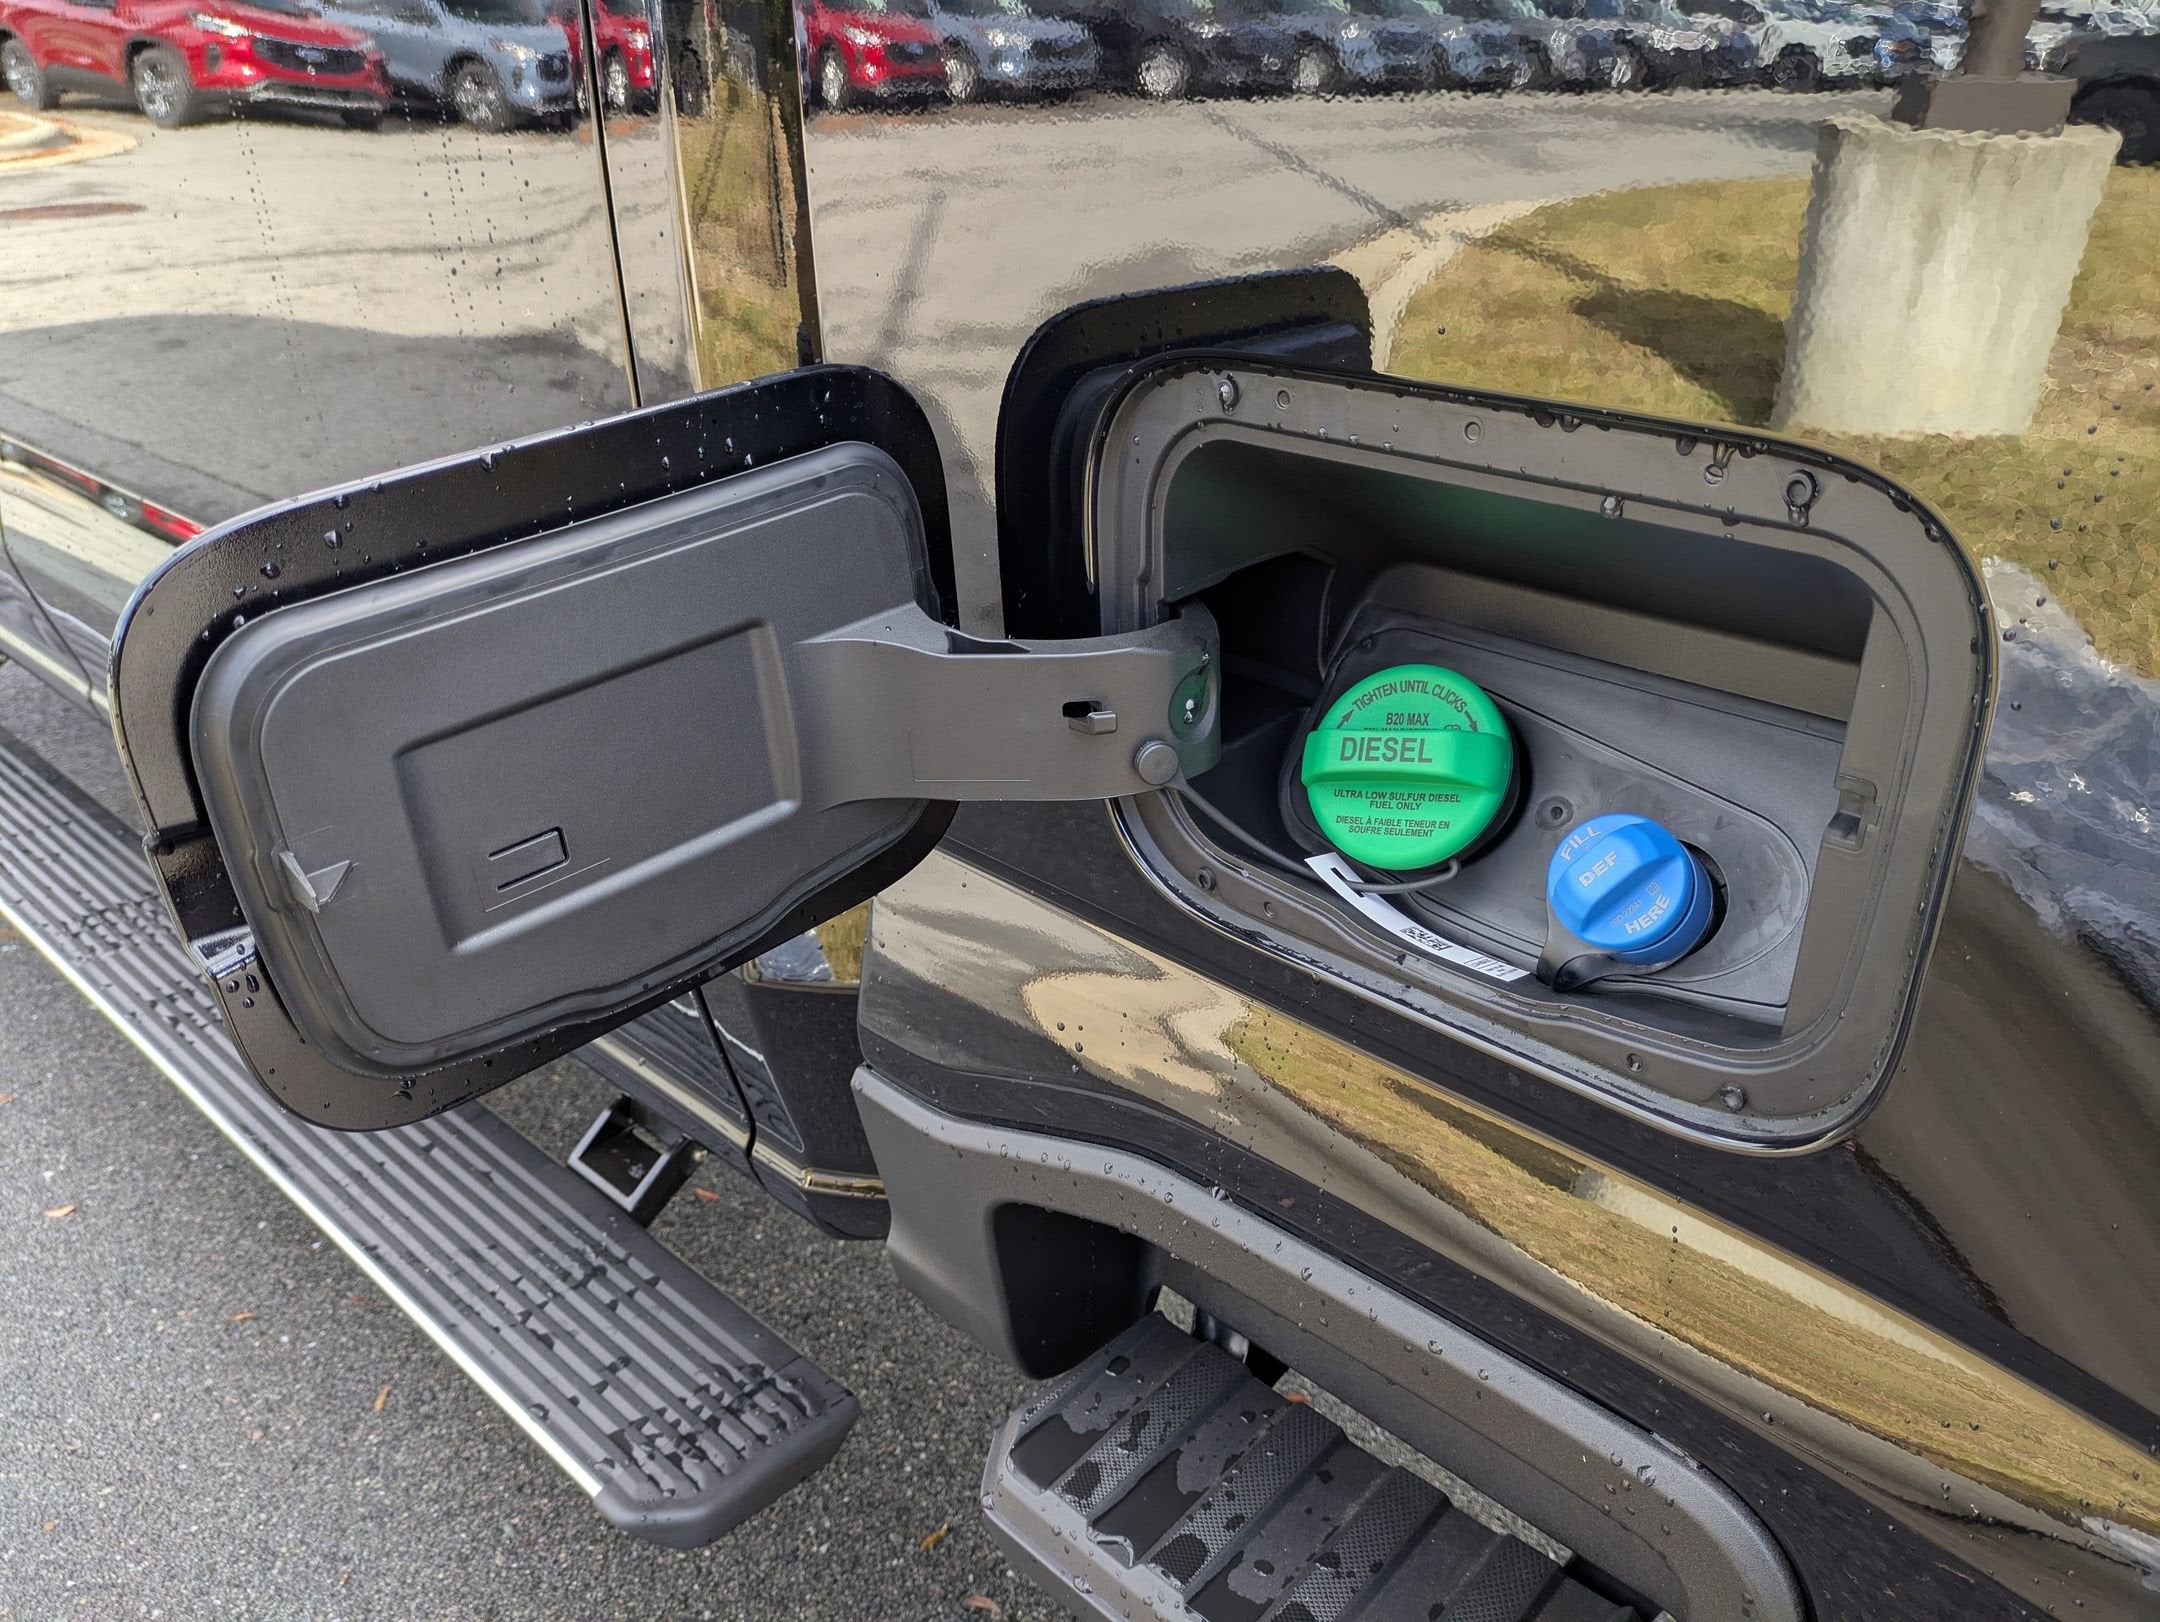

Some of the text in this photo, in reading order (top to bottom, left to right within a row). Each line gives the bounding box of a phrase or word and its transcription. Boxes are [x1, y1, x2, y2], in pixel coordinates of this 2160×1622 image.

[1352, 680, 1467, 713] TIGHTEN UNTIL CLICKS
[1386, 712, 1430, 726] B20 MAX
[1339, 736, 1433, 763] DIESEL
[1333, 789, 1461, 803] ULTRA LOW SULFUR DIESEL
[1369, 801, 1423, 811] FUEL ONLY
[1336, 815, 1450, 829] DIESEL À FAIBLE TENEUR EN
[1348, 825, 1435, 838] SOUFRE SEULEMENT
[1560, 825, 1602, 861] FILL
[1578, 851, 1617, 887] DEF
[1624, 895, 1671, 935] HERE
